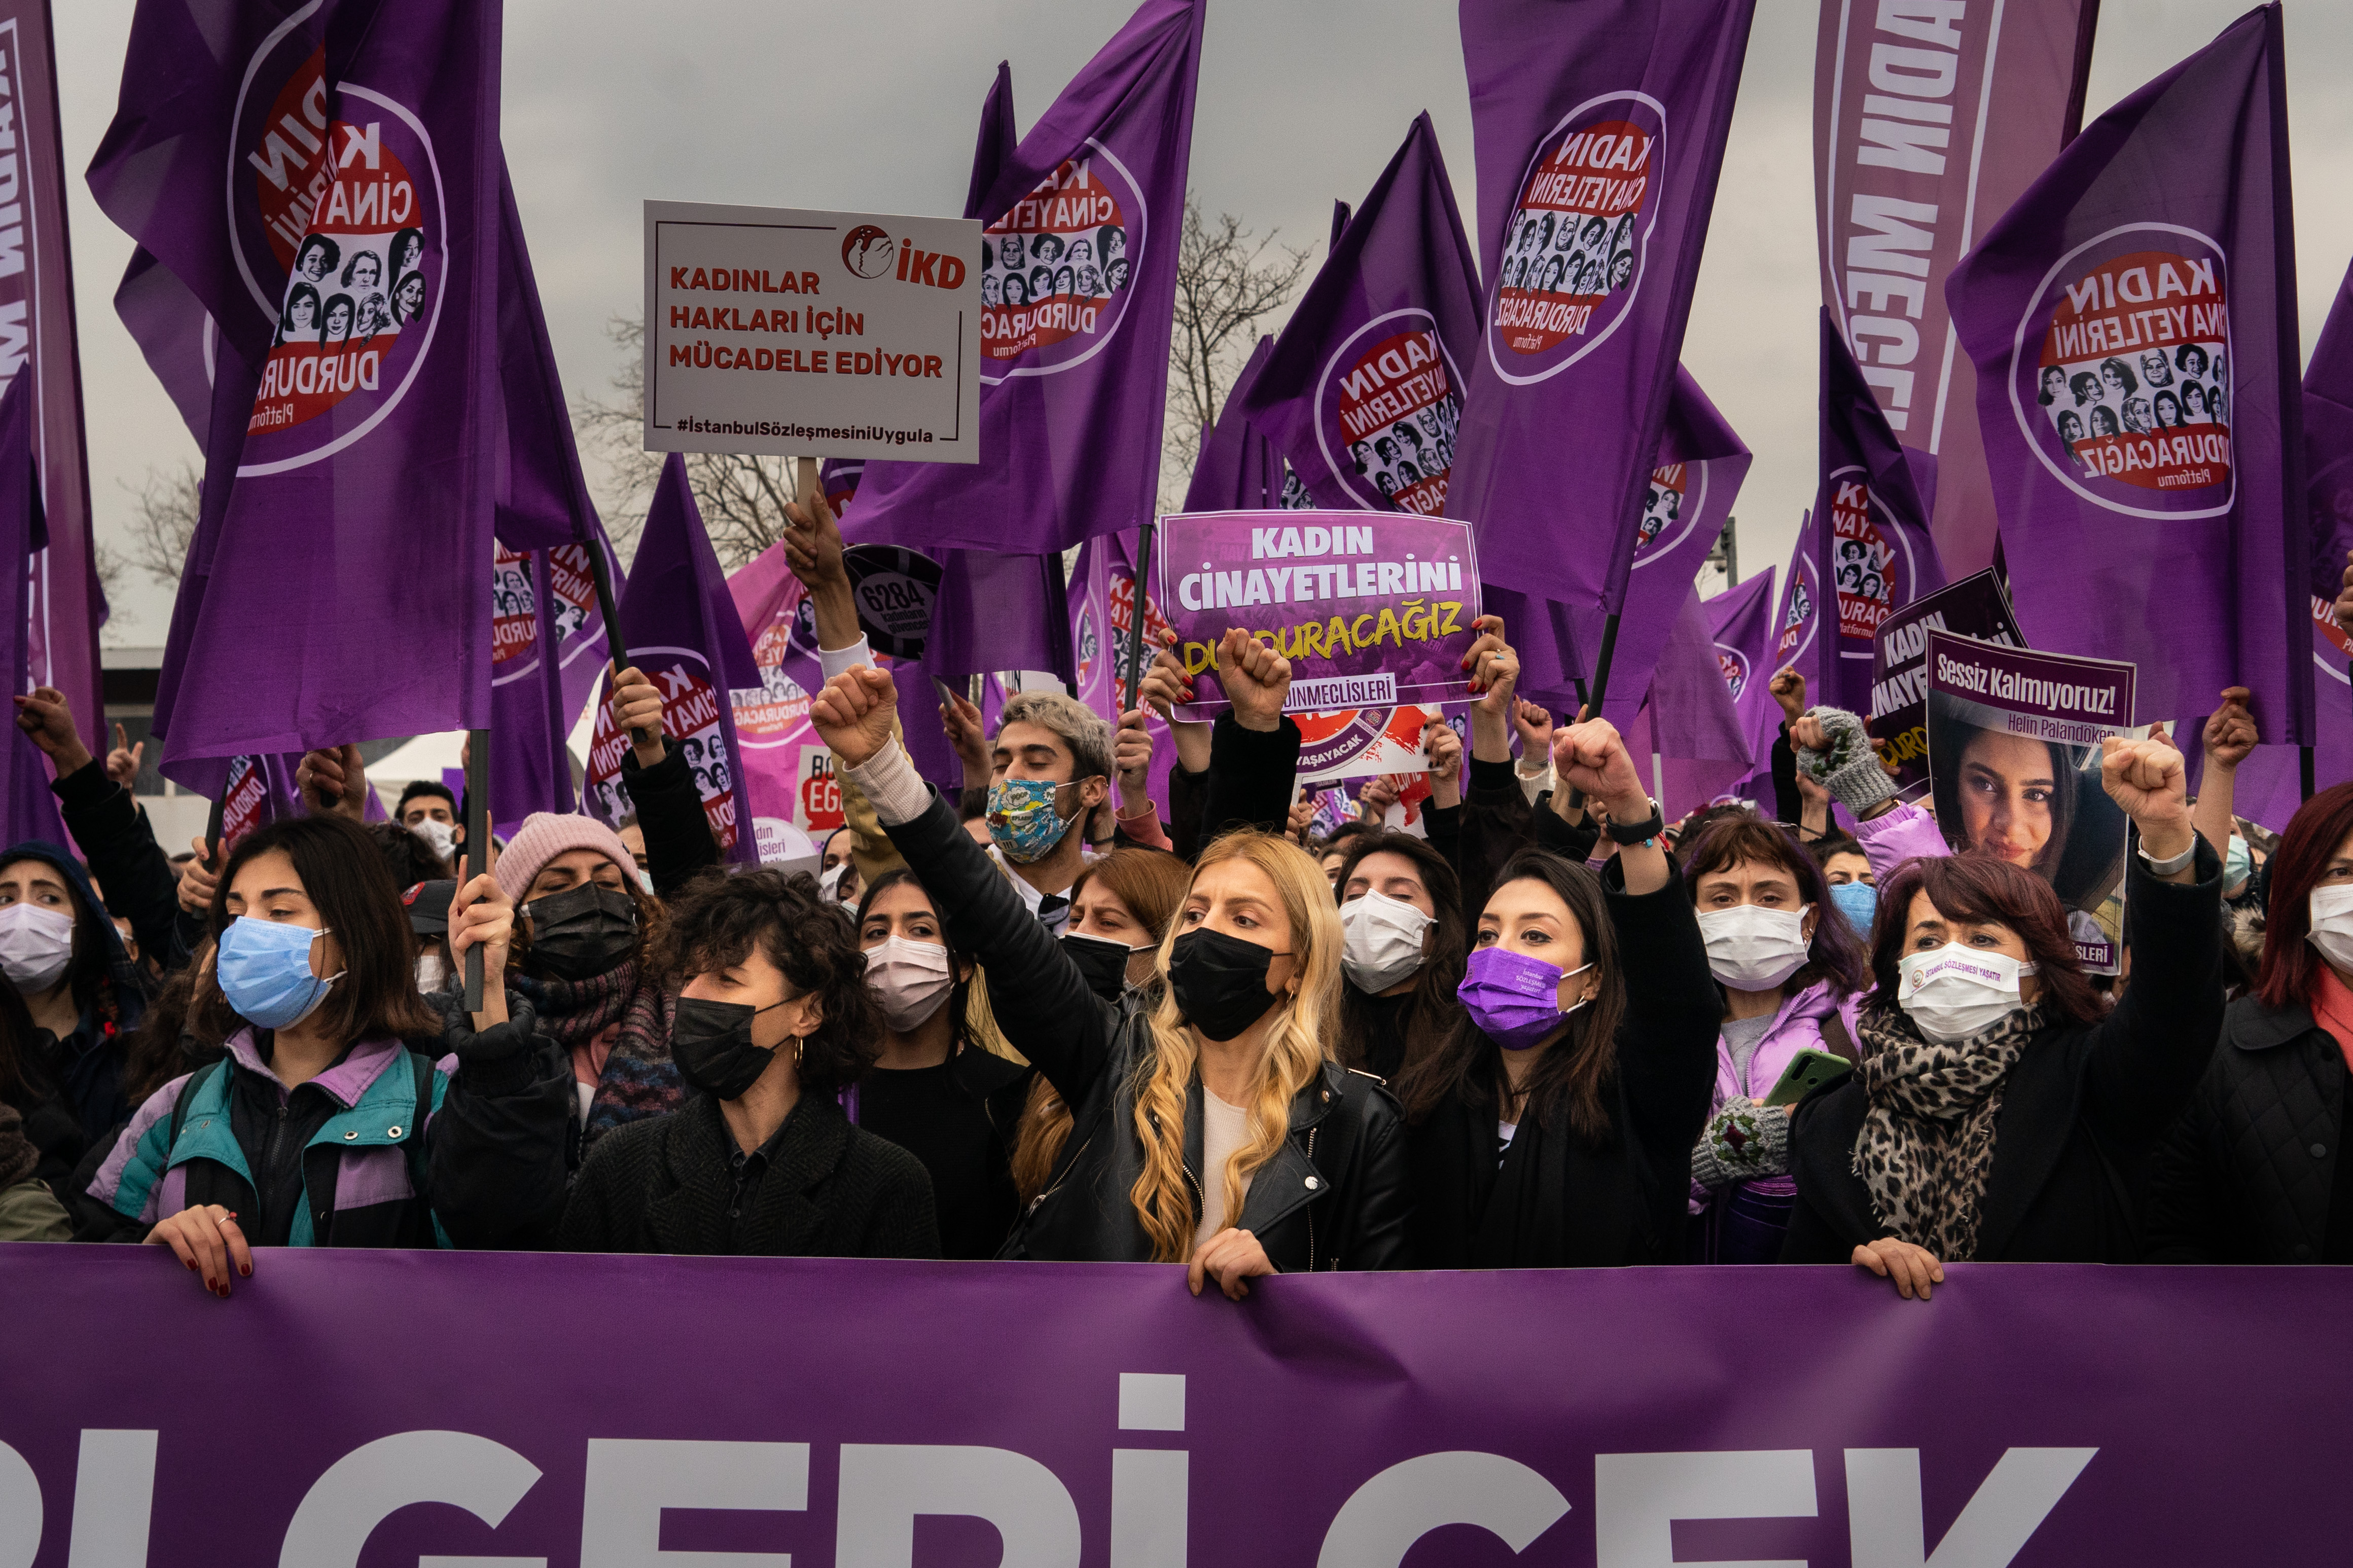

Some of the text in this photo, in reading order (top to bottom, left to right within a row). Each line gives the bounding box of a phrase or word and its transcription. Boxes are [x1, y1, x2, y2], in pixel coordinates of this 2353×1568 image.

[670, 267, 820, 295] KADINLAR
[896, 238, 966, 290] İKD
[670, 305, 864, 340] HAKLARI İÇİN
[669, 340, 942, 378] MÜCADELE EDİYOR
[677, 415, 933, 445] #İstanbulSözleşmesiniUygula
[1252, 526, 1373, 559] KADIN
[861, 579, 925, 612] 6284
[1179, 553, 1463, 611] CİNAYETLERİNİ
[1184, 598, 1464, 676] DUDURACAĞIZ
[1938, 653, 2116, 715] Sessiz Kalmıyoruz!
[2008, 713, 2037, 735] Helin
[1944, 959, 1978, 975] SÖZLEŞMESİ
[1979, 967, 2001, 982] YAŞATIR
